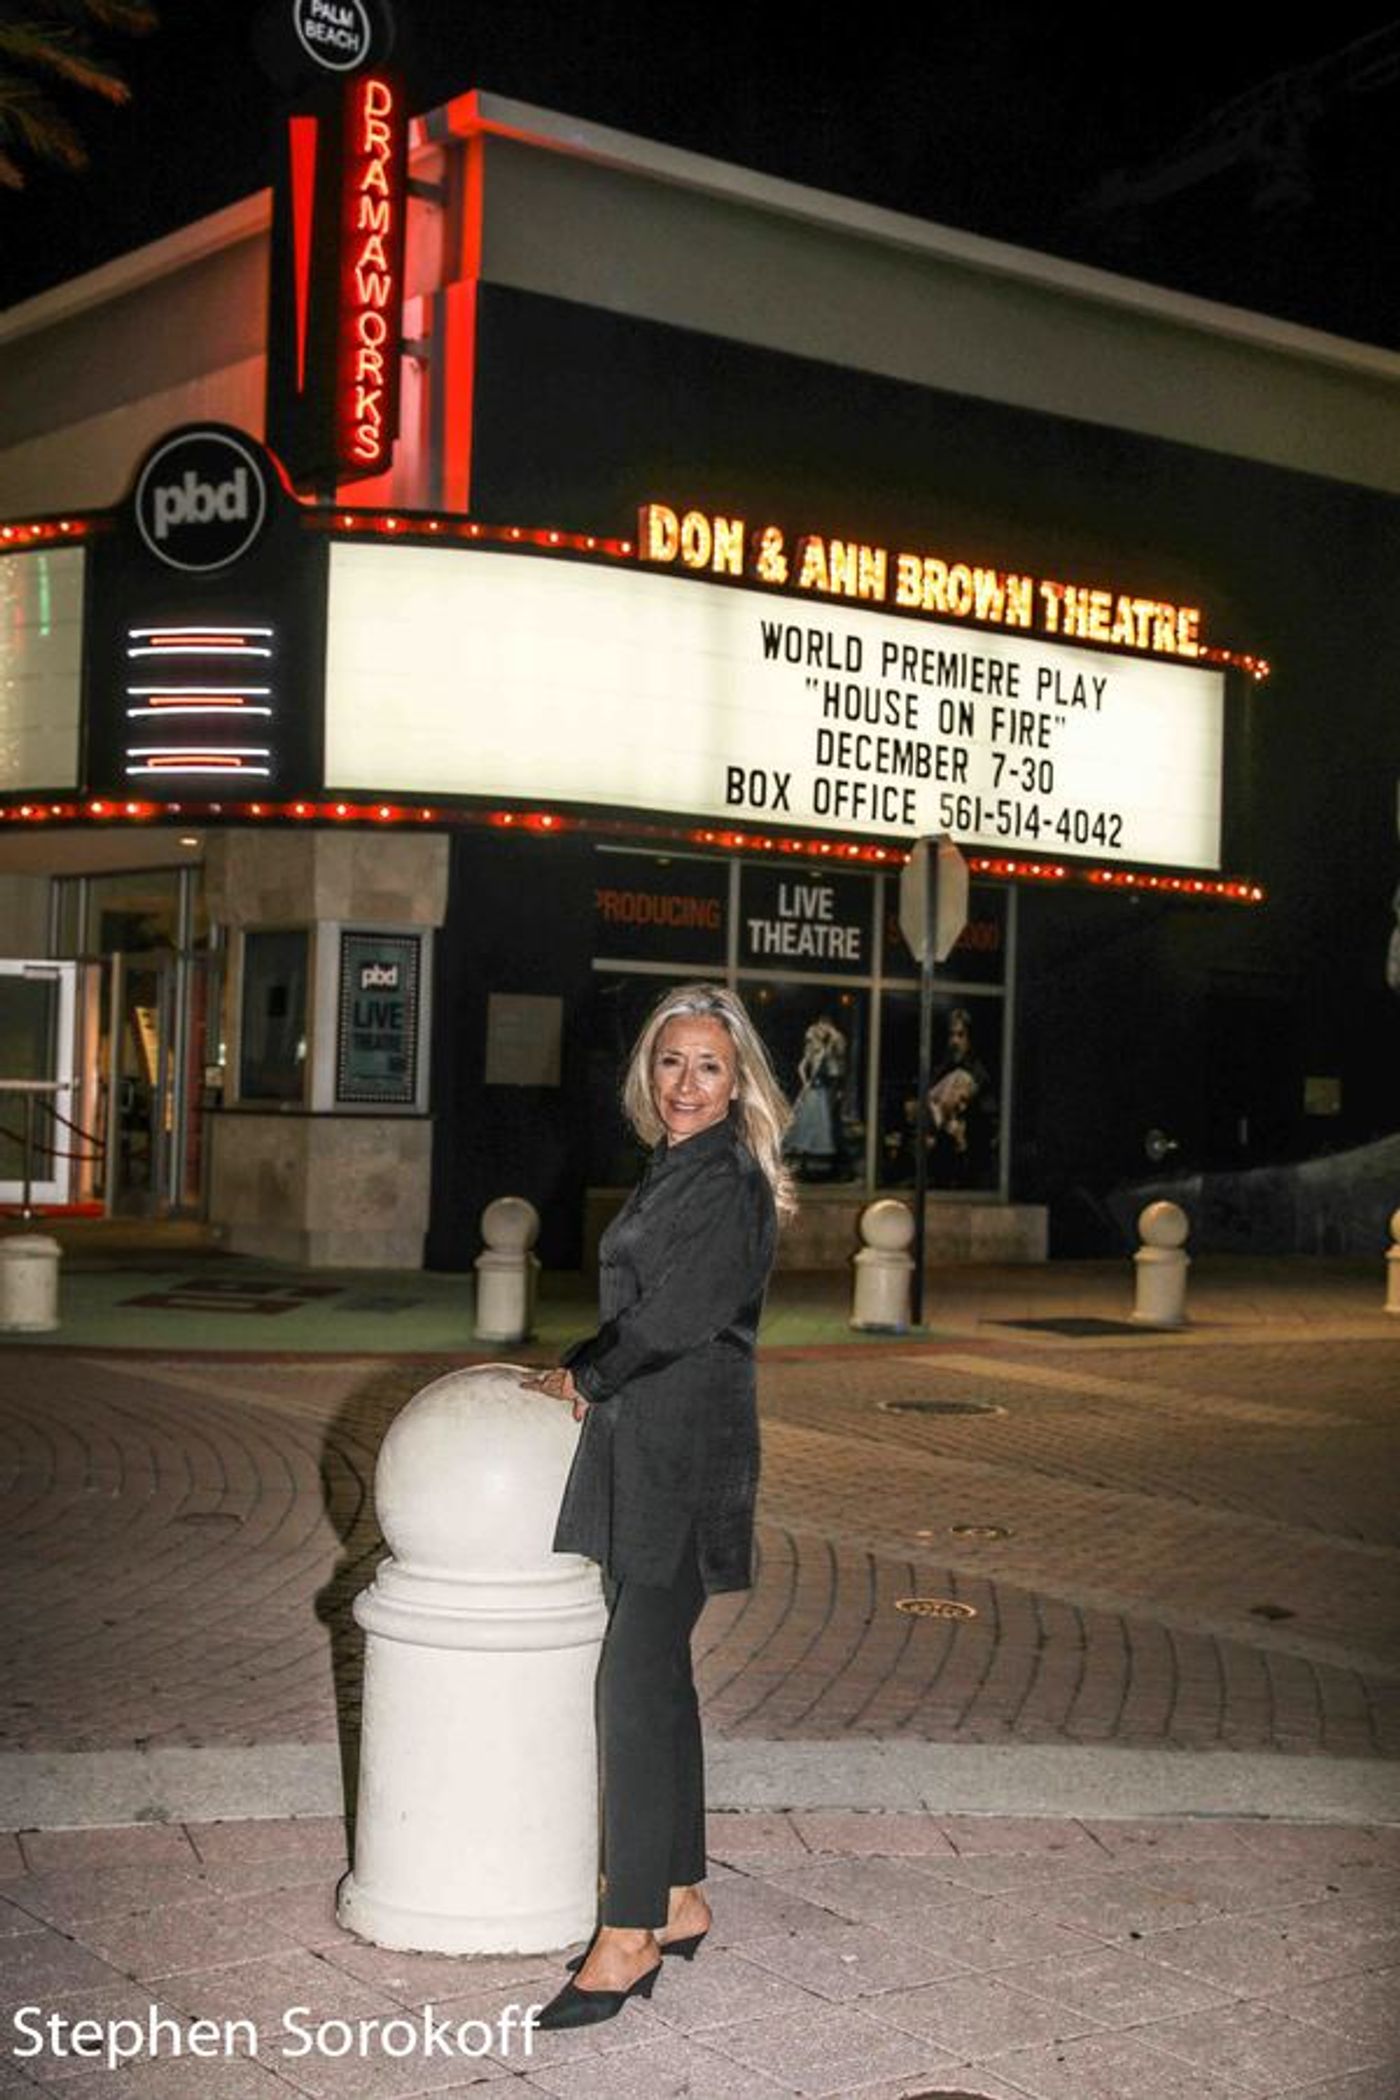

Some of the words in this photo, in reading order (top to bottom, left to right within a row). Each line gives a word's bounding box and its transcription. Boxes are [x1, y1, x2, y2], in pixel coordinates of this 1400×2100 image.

[305, 19, 359, 52] BEACH
[312, 0, 354, 28] PALM
[354, 80, 392, 459] DRAMAWORKS
[154, 466, 247, 538] pbd
[643, 503, 744, 575] DON
[754, 526, 788, 584] &
[798, 534, 887, 600] ANN
[896, 553, 1033, 628] BROWN
[1040, 580, 1200, 658] THEATRE
[761, 621, 863, 673] WORLD
[881, 641, 1020, 698] PREMIERE
[1037, 667, 1107, 711] PLAY
[805, 680, 918, 731] "HOUSE
[939, 699, 974, 737] ON
[991, 706, 1066, 749] FIRE"
[816, 728, 968, 783] DECEMBER
[992, 752, 1054, 795] 7-30
[725, 765, 791, 811] BOX
[813, 777, 916, 825] OFFICE
[939, 793, 1122, 849] 561-514-4042
[778, 884, 834, 920] LIVE
[748, 919, 861, 960] THEATRE
[361, 965, 398, 989] pbd
[354, 1001, 403, 1029] LIVE
